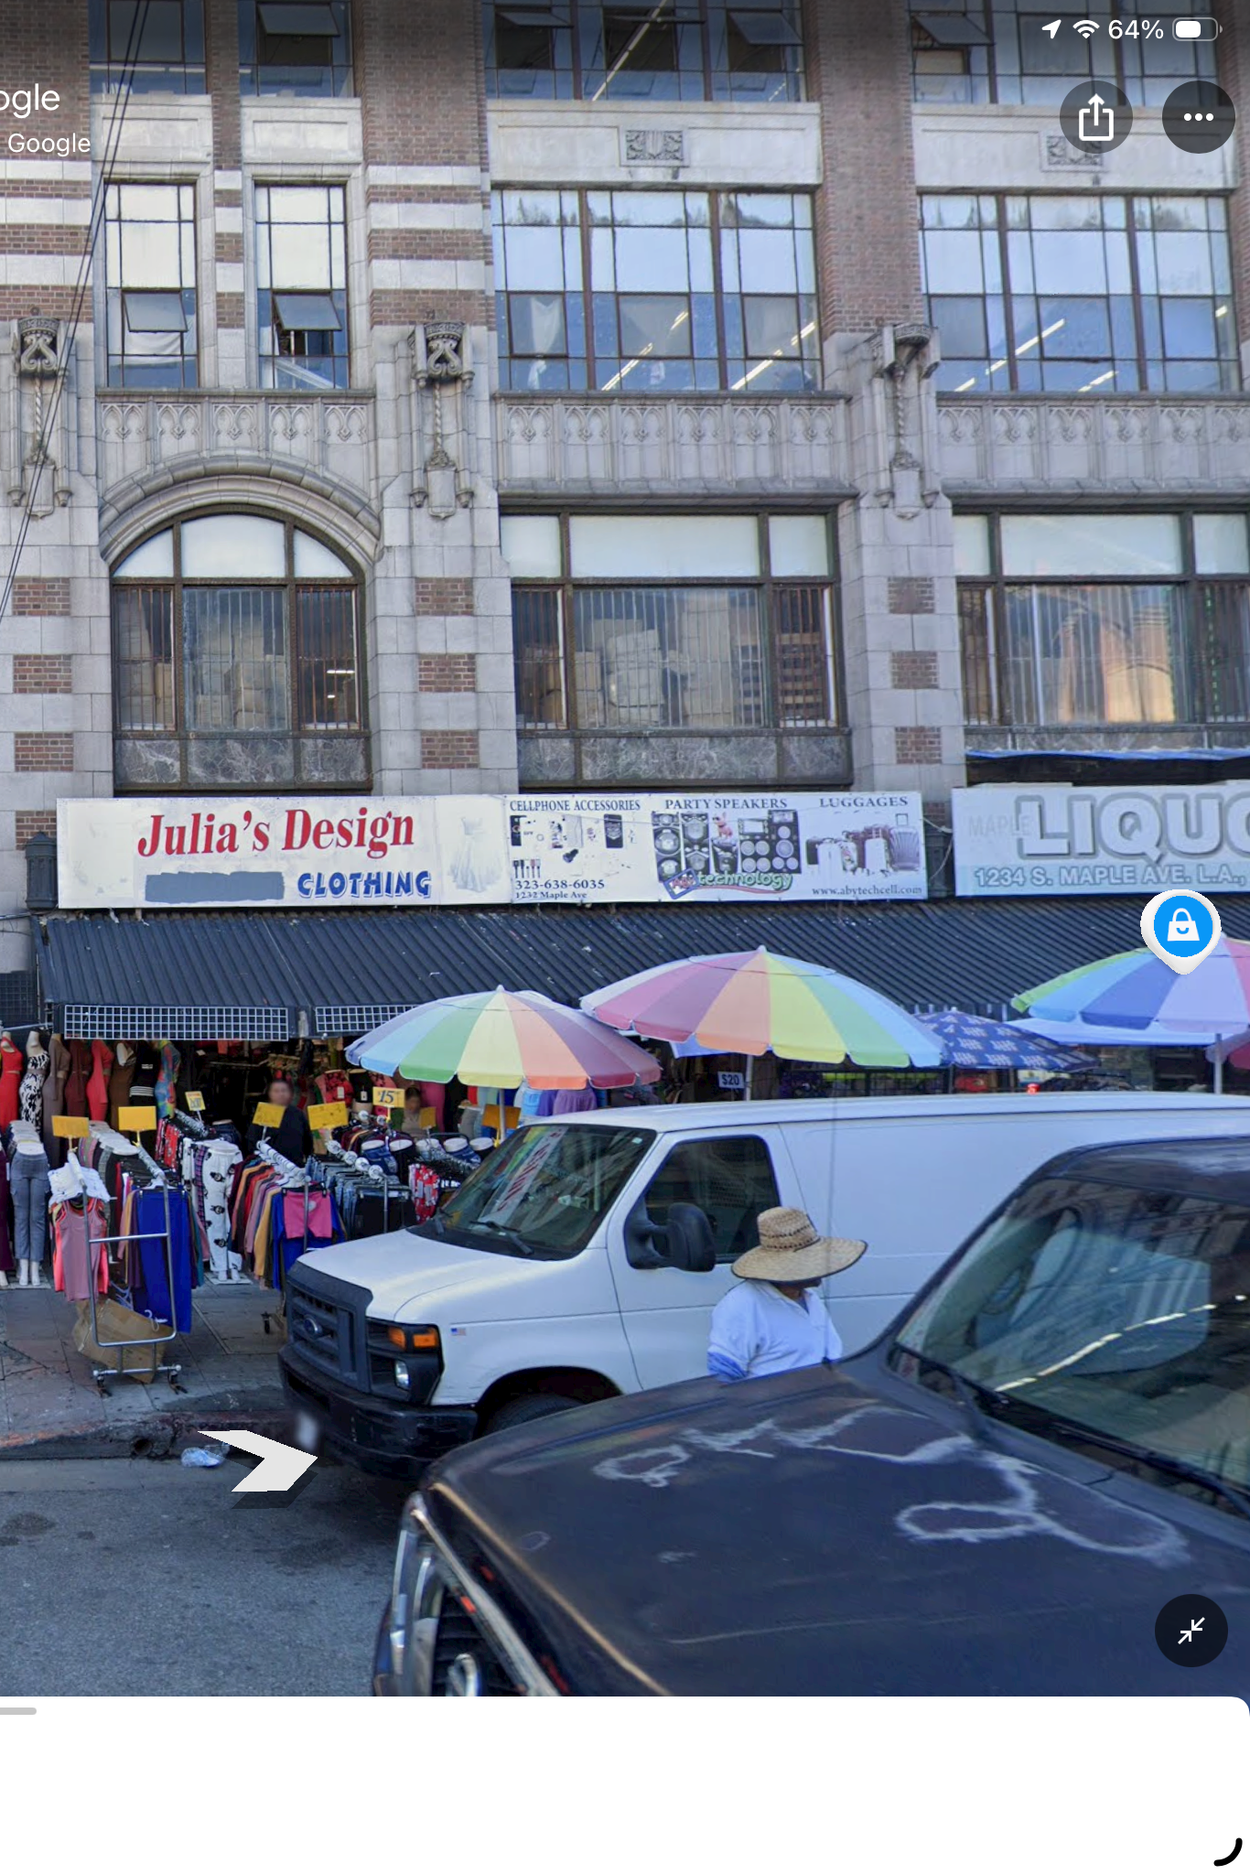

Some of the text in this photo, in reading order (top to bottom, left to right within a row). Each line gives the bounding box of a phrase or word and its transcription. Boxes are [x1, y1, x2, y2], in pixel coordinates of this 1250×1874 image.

[509, 799, 641, 812] CELLPHONE ACCESSORIES
[665, 798, 788, 810] PARTY SPEAKERS
[819, 796, 909, 808] LUGGAGES
[281, 807, 416, 860] Design
[698, 870, 793, 891] technology
[975, 867, 1026, 887] 1234
[1030, 866, 1053, 886] S.
[1059, 865, 1140, 886] MAPLE
[1142, 865, 1192, 885] AVE.
[297, 870, 432, 899] CLOTHING
[515, 879, 605, 890] 323-638-6035
[811, 884, 923, 897] www.abytechcell.com
[516, 891, 588, 900] 1232 Maple Ave
[721, 1073, 740, 1086] $20
